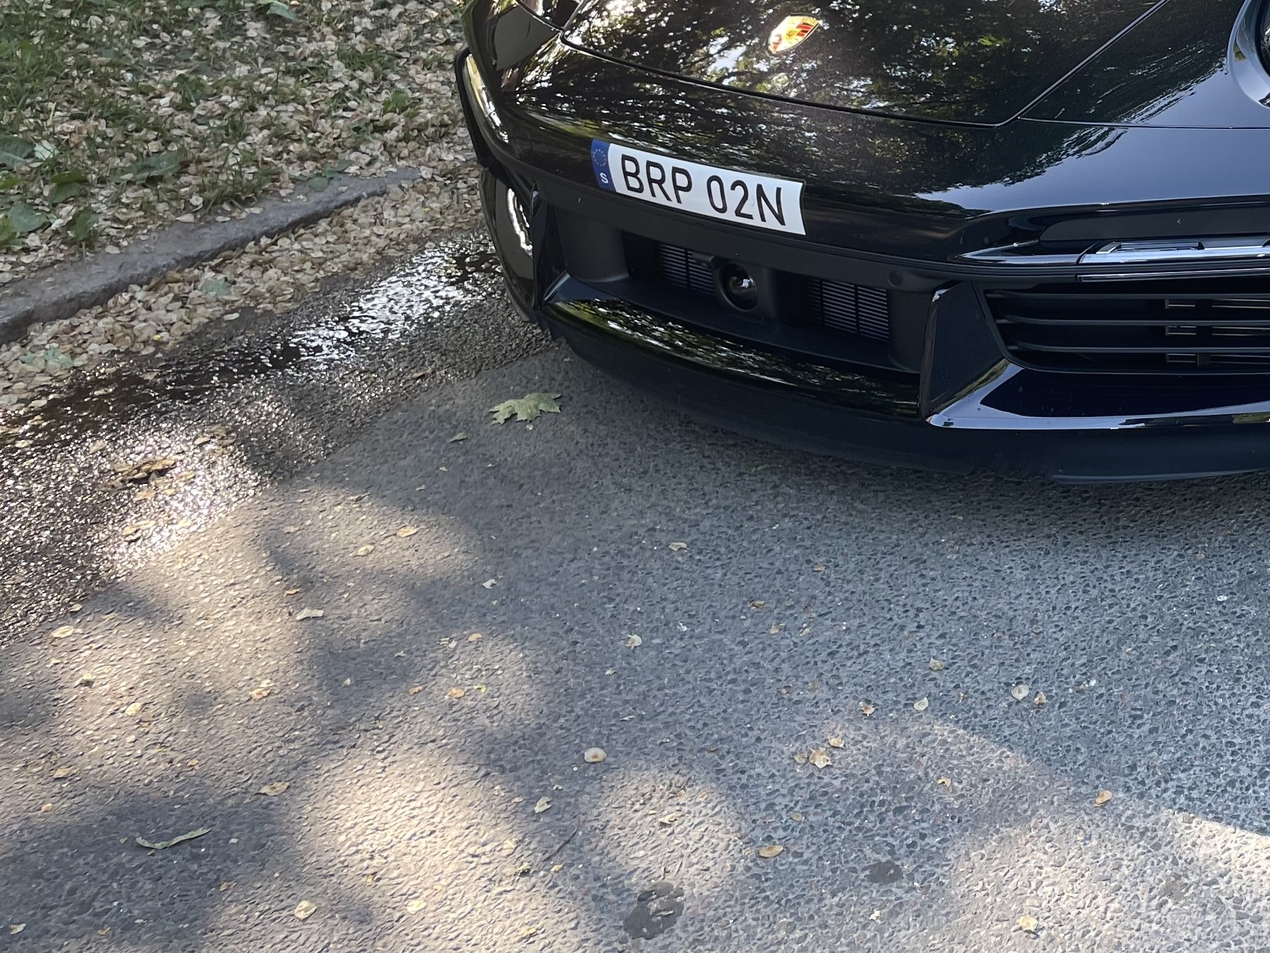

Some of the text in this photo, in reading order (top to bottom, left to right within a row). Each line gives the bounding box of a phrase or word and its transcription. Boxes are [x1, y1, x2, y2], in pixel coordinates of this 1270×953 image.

[600, 172, 609, 185] S
[620, 154, 786, 226] BRP 02N
